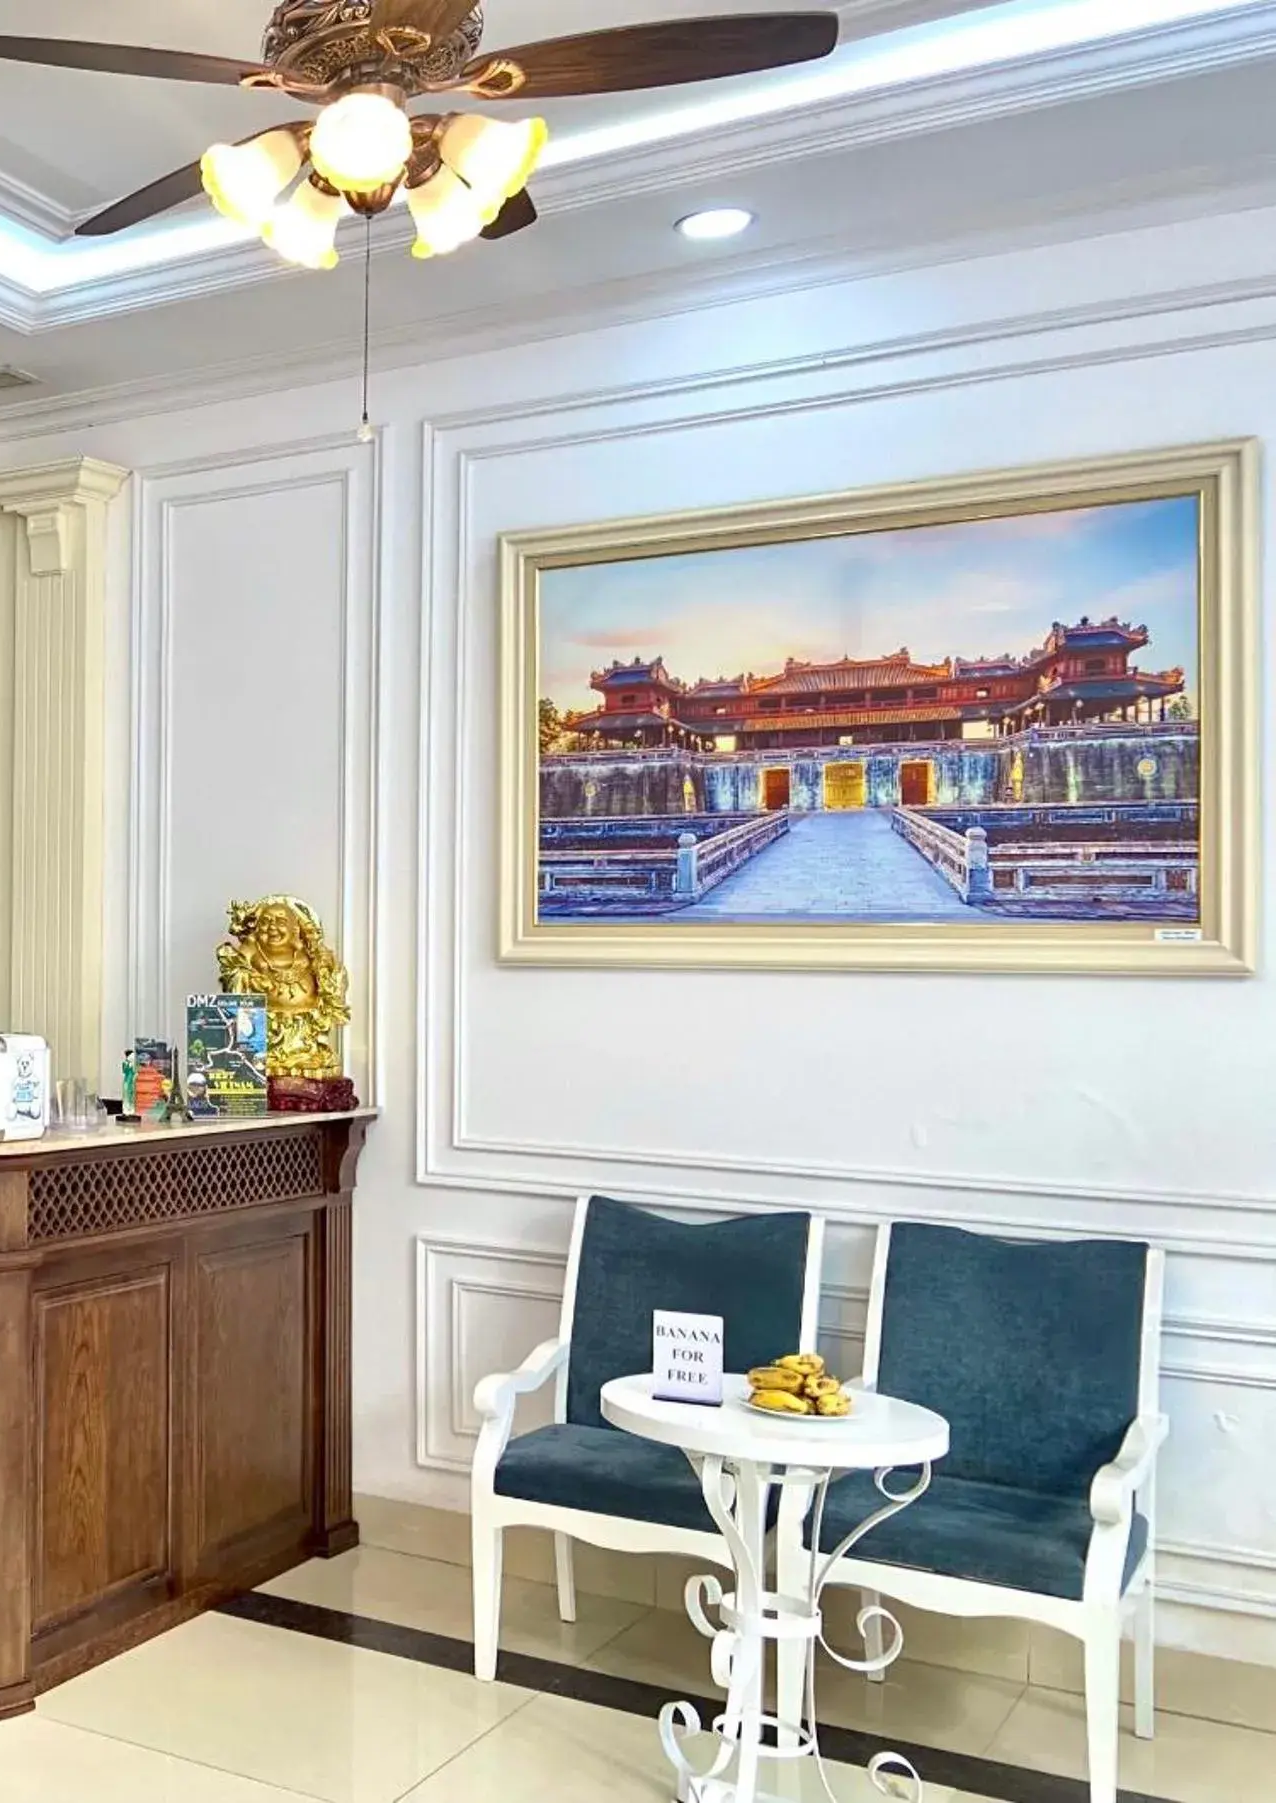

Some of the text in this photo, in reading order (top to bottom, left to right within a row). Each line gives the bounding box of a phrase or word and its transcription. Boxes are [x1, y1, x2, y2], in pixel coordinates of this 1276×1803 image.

[186, 994, 217, 1008] DMZ
[656, 1325, 721, 1344] BANANA
[672, 1348, 704, 1364] FOR
[667, 1369, 708, 1385] FREE
